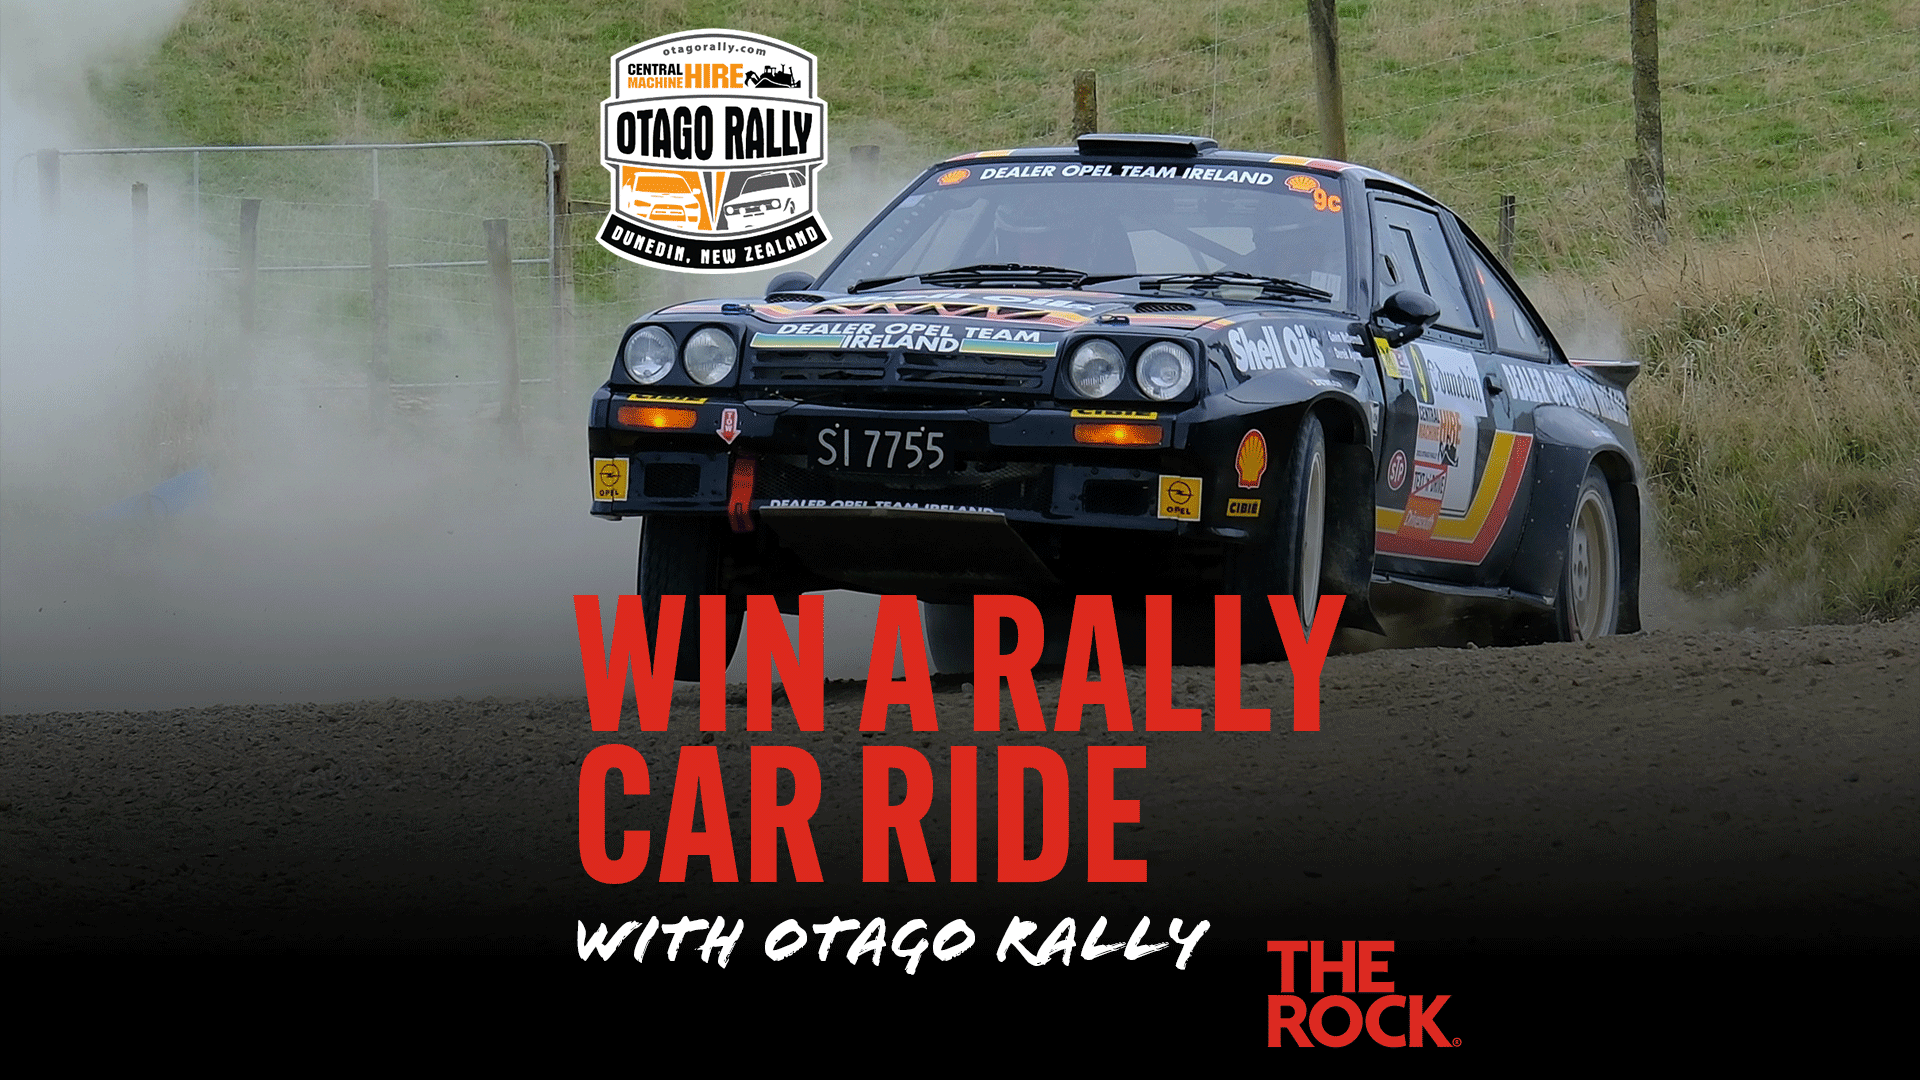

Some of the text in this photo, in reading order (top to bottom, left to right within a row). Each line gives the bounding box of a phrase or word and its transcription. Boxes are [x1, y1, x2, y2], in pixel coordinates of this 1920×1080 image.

[980, 164, 1274, 186] DEALER OPEL TEAM IRELAND
[776, 323, 1040, 342] DEALER OPEL TEAM
[841, 334, 959, 352] IRELAND
[1228, 325, 1287, 372] Shell
[1283, 324, 1326, 368] Oils
[1501, 363, 1553, 404] DEALER
[724, 412, 734, 433] TOW
[864, 430, 944, 470] 7755
[1389, 455, 1404, 482] STP
[599, 489, 619, 498] OPEL
[1166, 506, 1192, 516] OPEL
[1228, 502, 1258, 514] CIBIE
